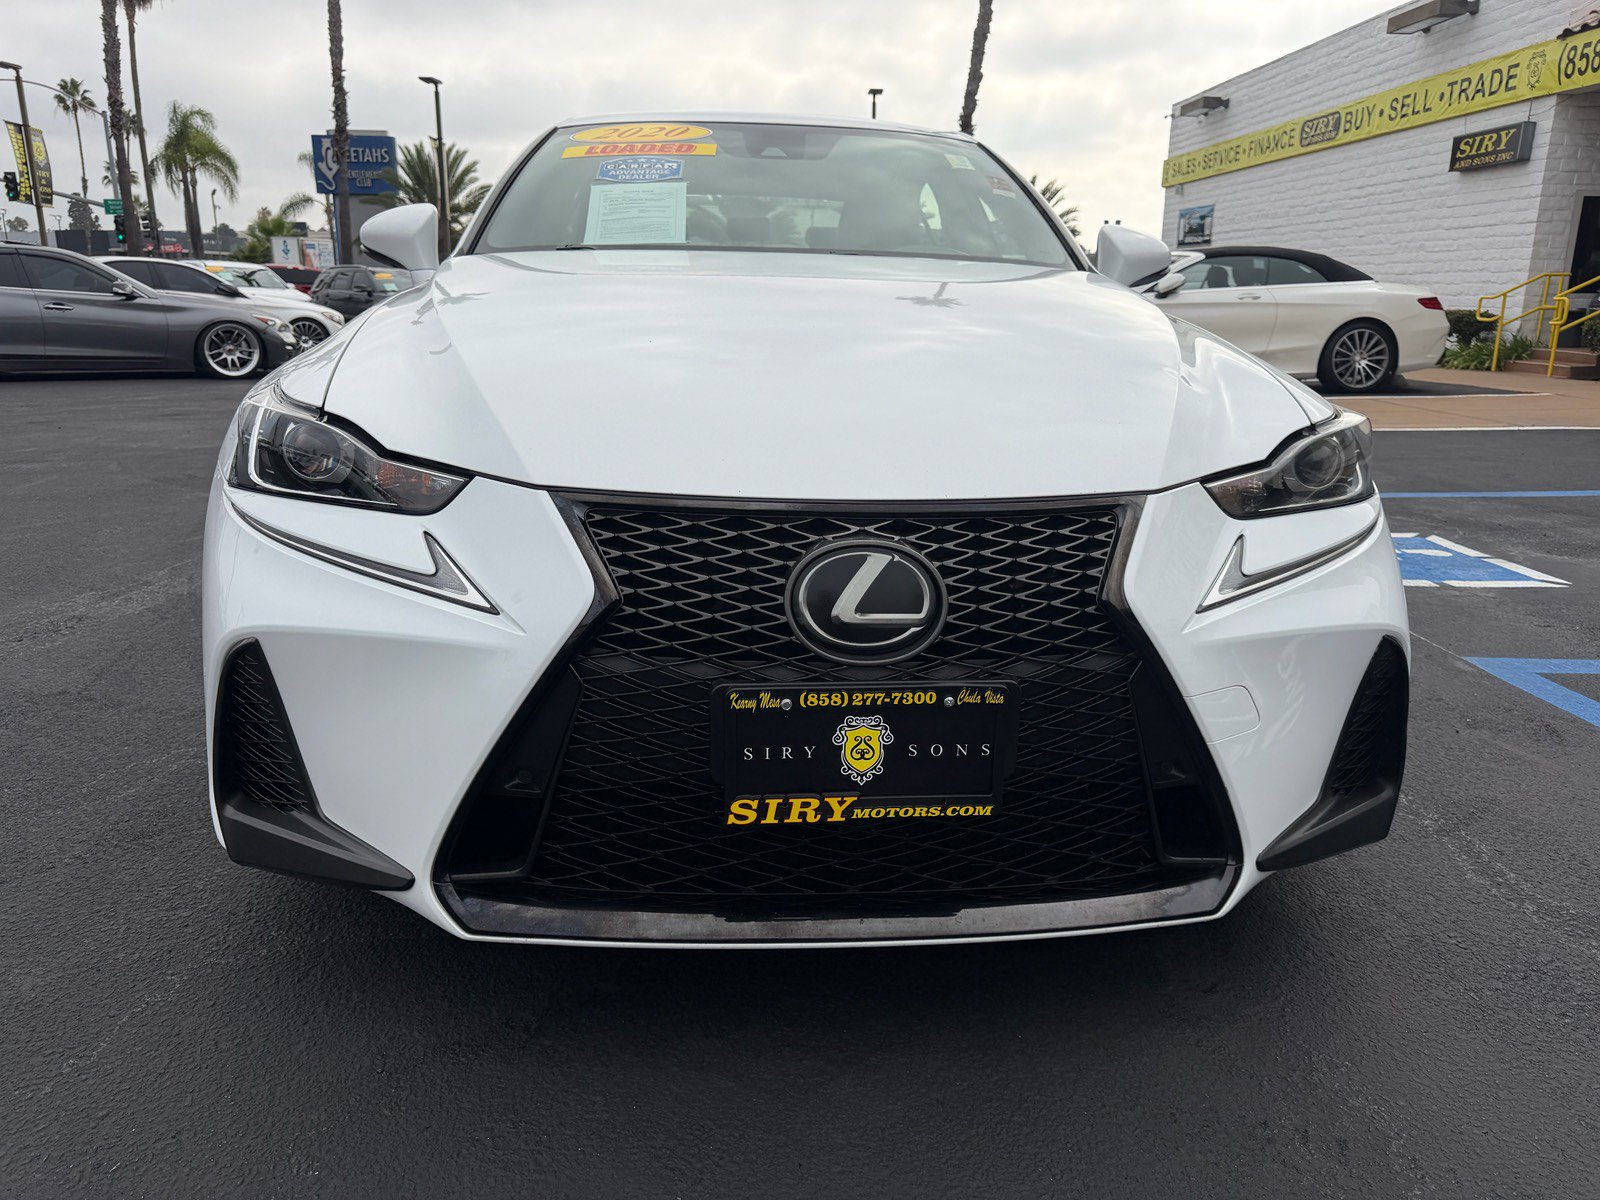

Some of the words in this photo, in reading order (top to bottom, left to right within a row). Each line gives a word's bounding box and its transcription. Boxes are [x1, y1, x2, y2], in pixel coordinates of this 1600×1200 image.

[1342, 103, 1377, 133] BUY
[1388, 89, 1434, 122] SELL
[1446, 62, 1521, 107] TRADE
[593, 126, 691, 140] 2020
[1302, 113, 1340, 138] SIRY
[584, 143, 698, 155] LOADED
[1172, 158, 1197, 178] SALES
[1202, 145, 1242, 171] SERVICE
[1247, 128, 1296, 158] FINANCE
[1455, 128, 1517, 159] SIRY
[605, 162, 677, 170] CARFAX
[729, 692, 757, 713] Kearny
[759, 691, 781, 708] Mesa
[799, 690, 849, 708] (858)
[852, 691, 937, 706] 277-7300
[957, 689, 982, 705] Chula
[984, 690, 1005, 704] Vista
[743, 746, 816, 760] SIRY
[908, 743, 990, 757] SONS
